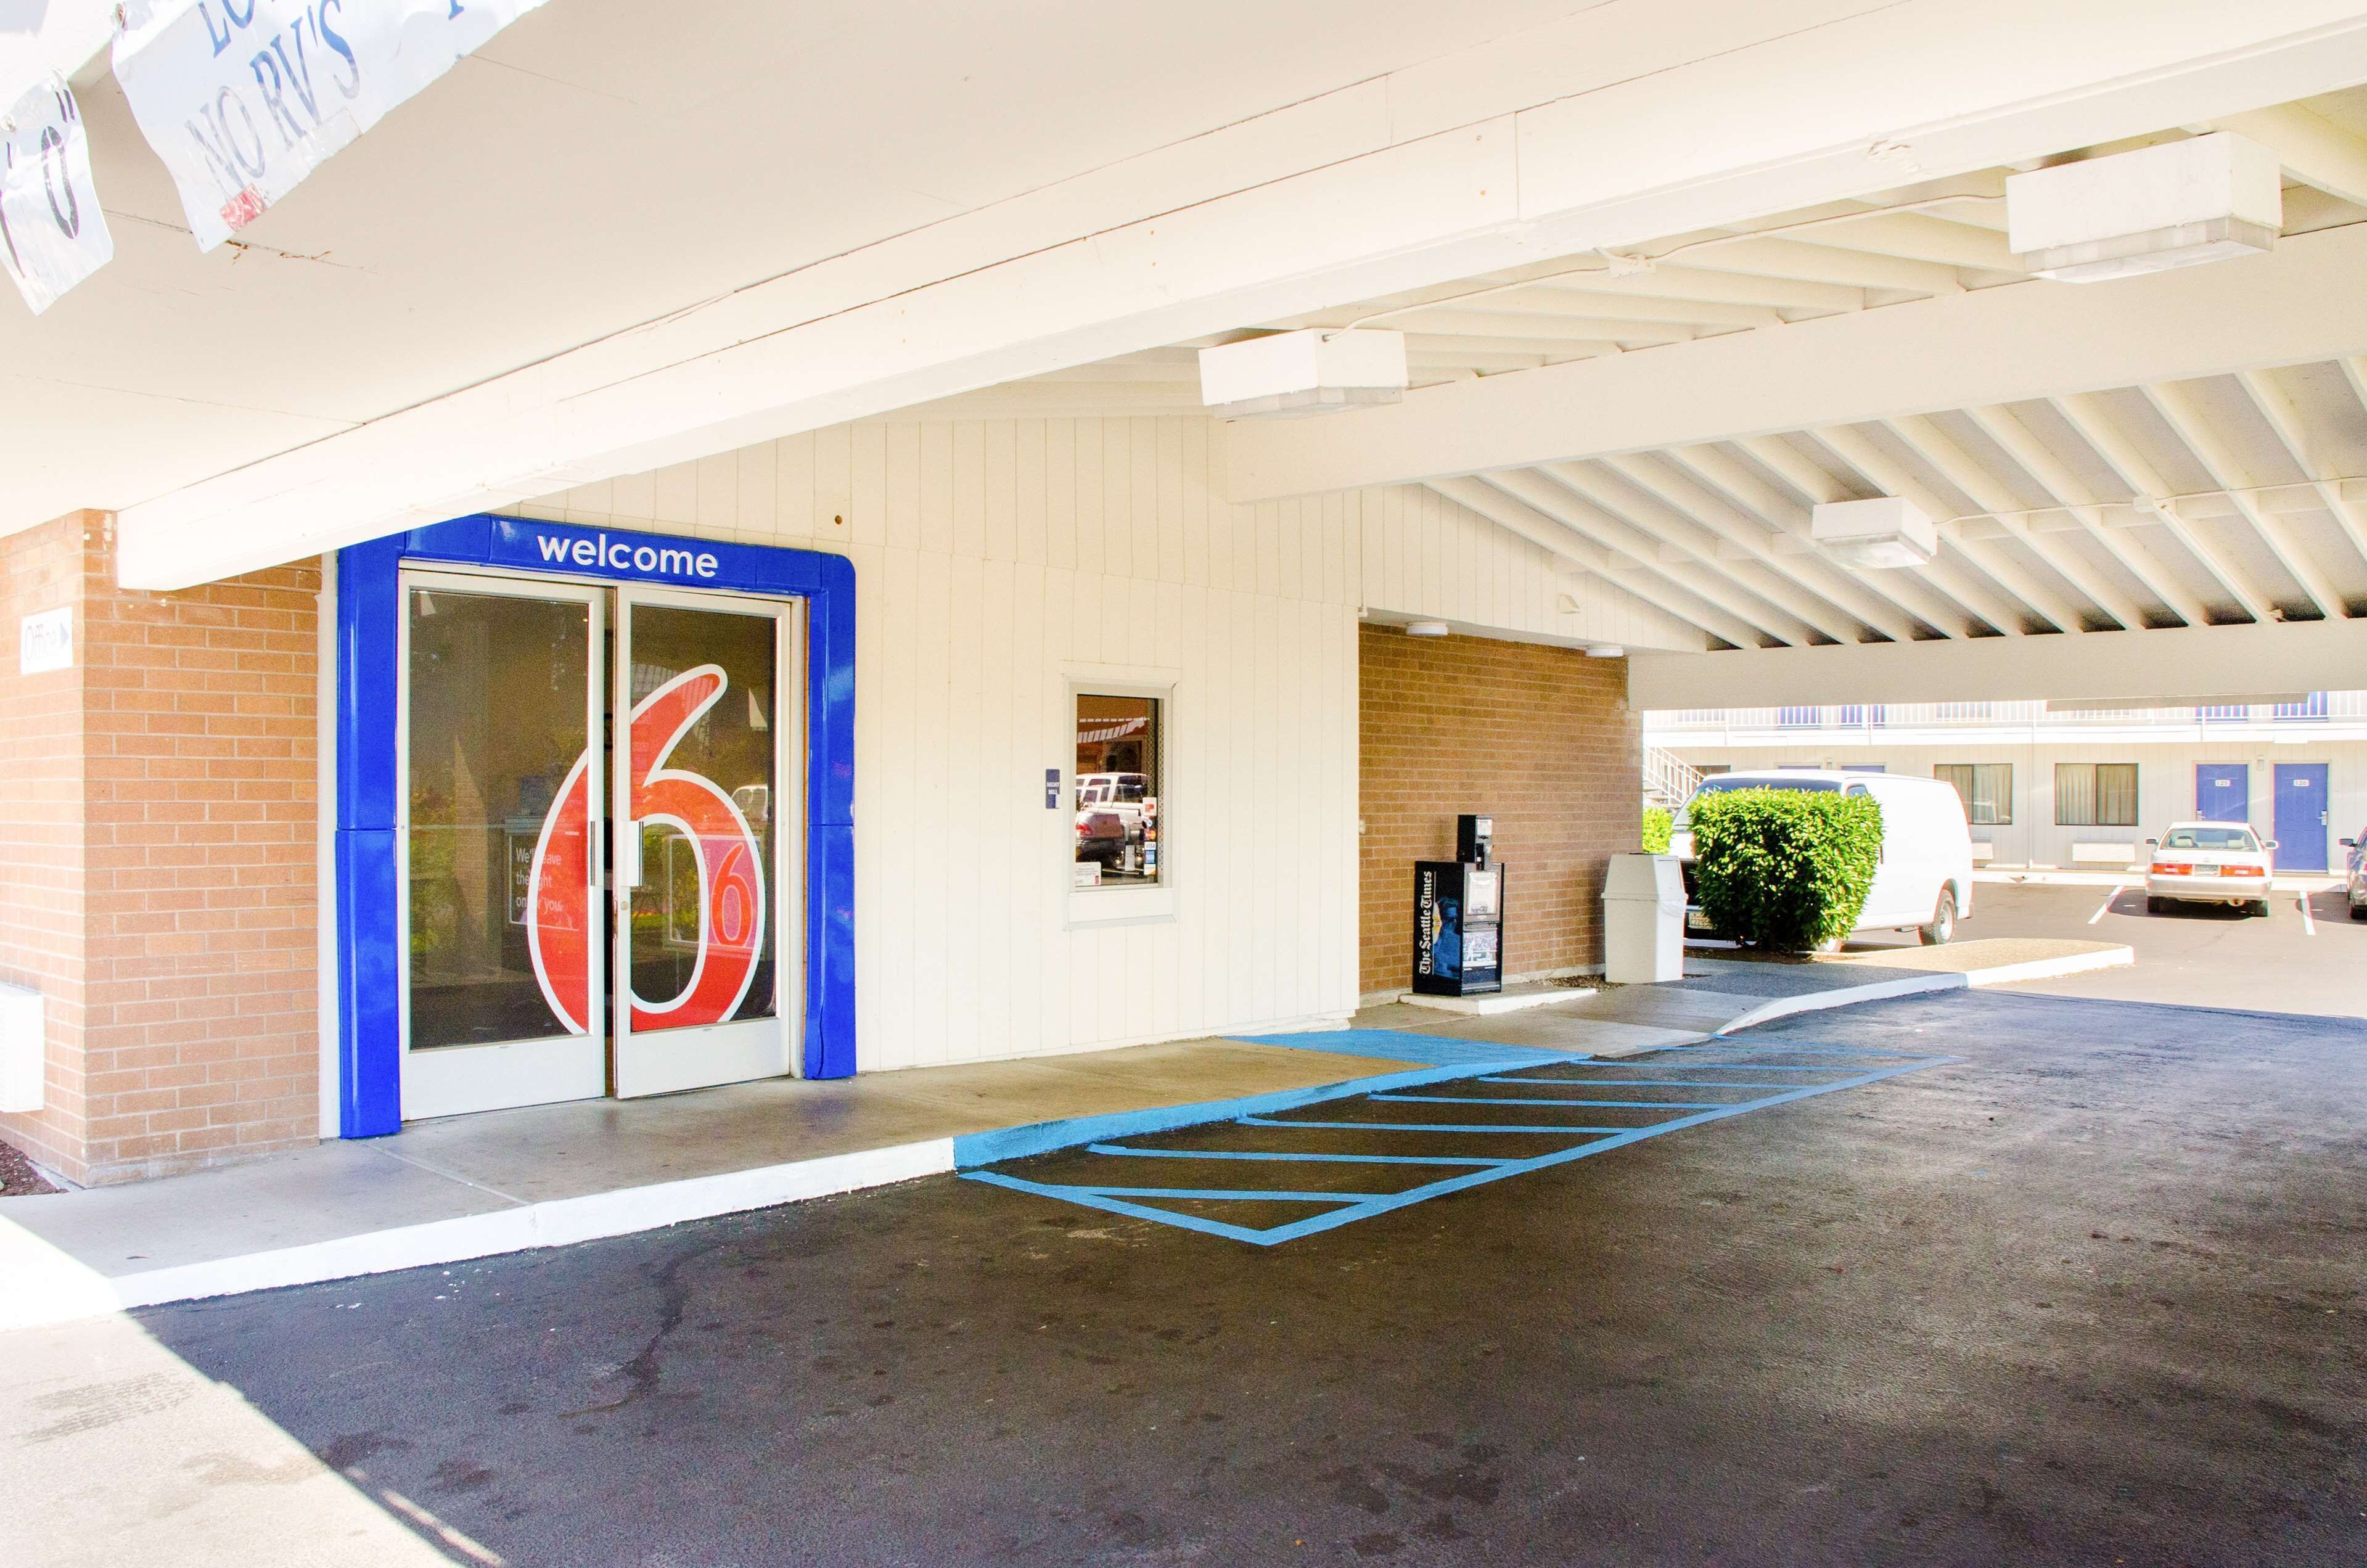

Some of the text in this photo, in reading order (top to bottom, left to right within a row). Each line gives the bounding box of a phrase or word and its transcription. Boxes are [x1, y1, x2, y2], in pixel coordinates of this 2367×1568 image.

[184, 85, 266, 198] NO
[537, 533, 719, 578] welcome
[527, 663, 766, 1035] 6
[1419, 871, 1432, 975] The Seattle Times
